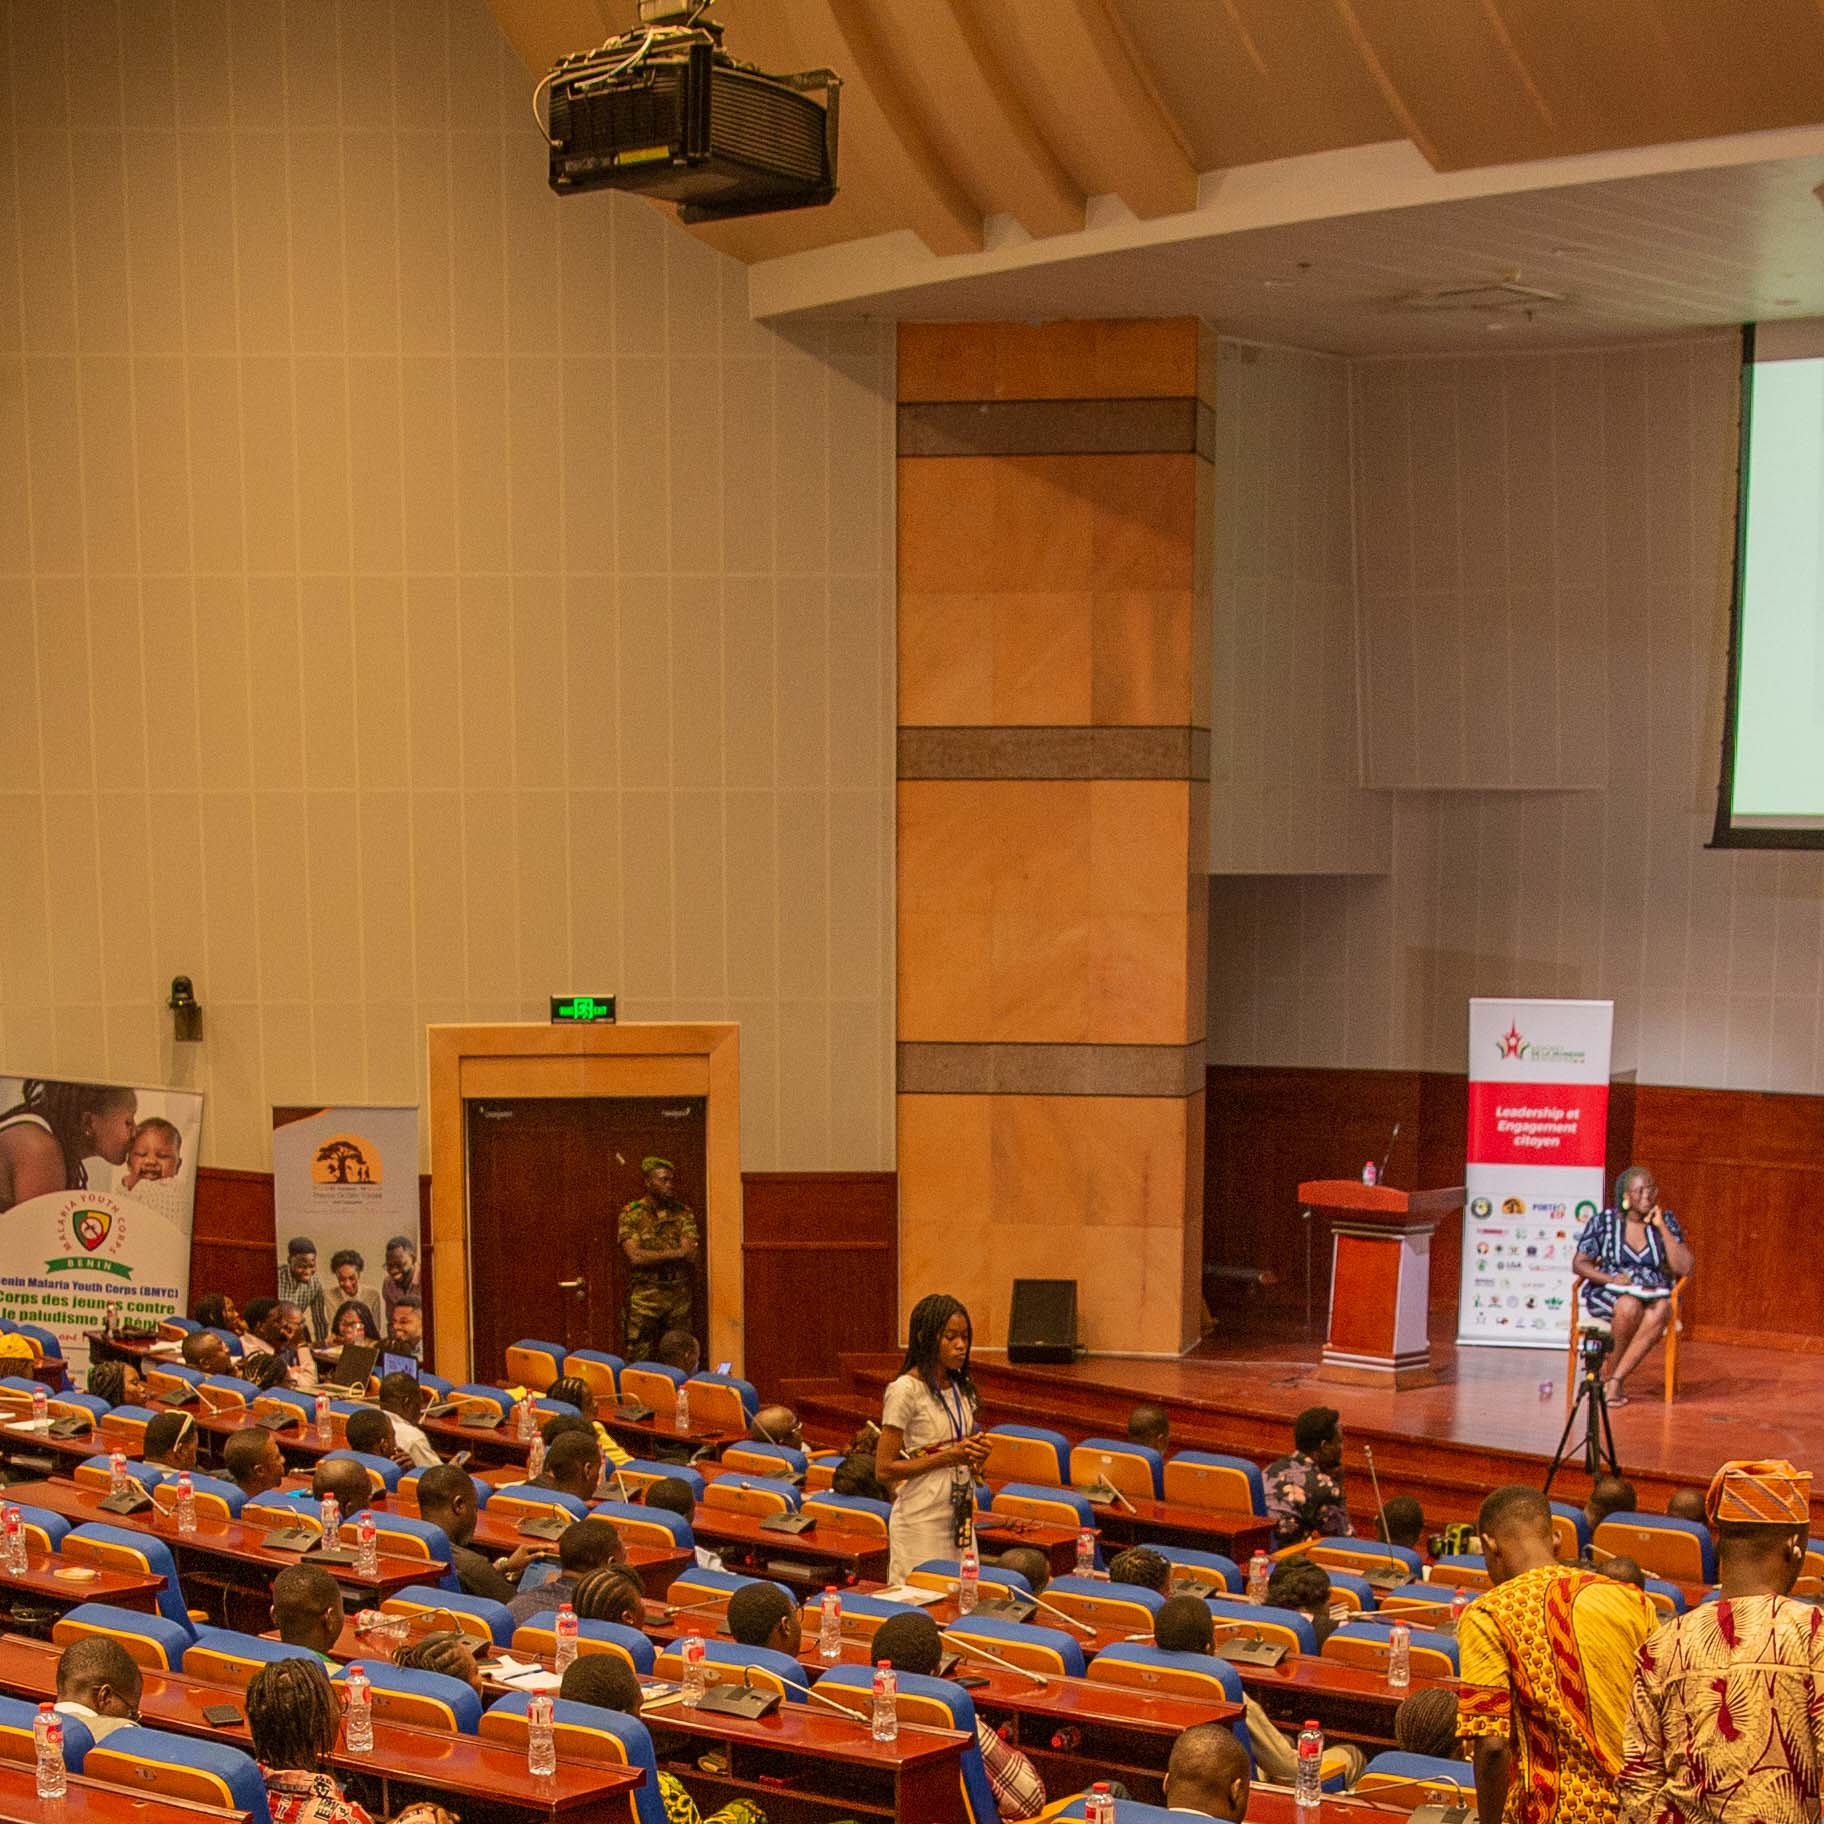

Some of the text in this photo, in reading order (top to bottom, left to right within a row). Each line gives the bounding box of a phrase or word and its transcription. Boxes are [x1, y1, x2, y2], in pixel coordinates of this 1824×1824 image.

[1496, 1106, 1580, 1120] Leadership et
[1497, 1120, 1578, 1135] Engagement
[1513, 1134, 1561, 1149] citoyen
[80, 1193, 120, 1214] YOUTH
[67, 1258, 113, 1272] BENIN
[28, 1278, 70, 1291] Malaria
[72, 1281, 103, 1293] Youth
[105, 1283, 137, 1296] Corps
[42, 1294, 69, 1306] des
[72, 1296, 123, 1312] jeuns
[127, 1302, 176, 1315] contre
[2, 1307, 16, 1320] le
[19, 1308, 98, 1327] paludisme
